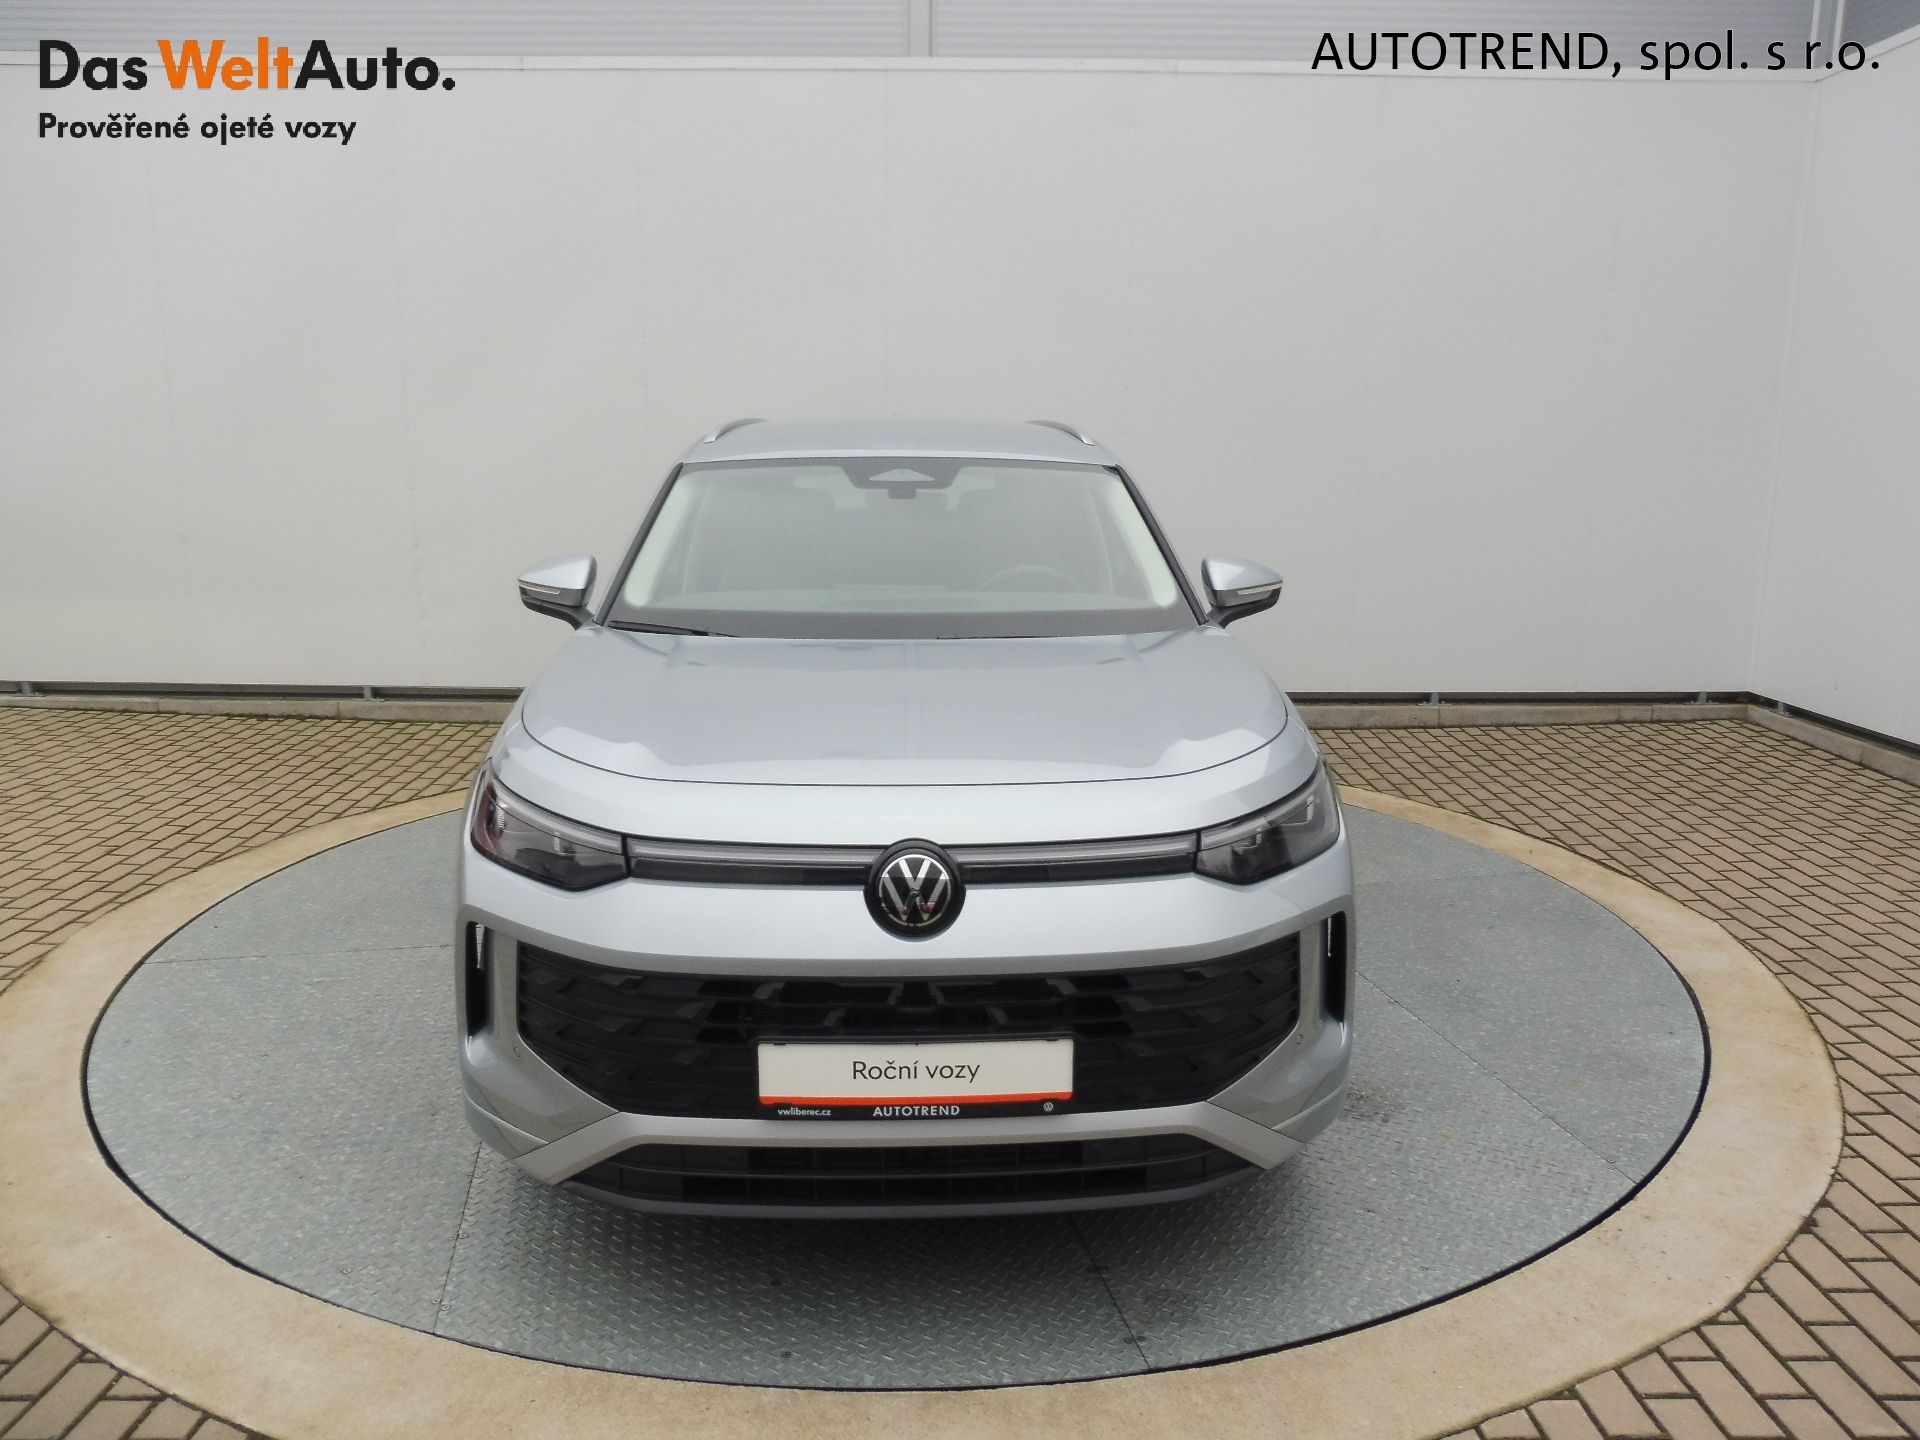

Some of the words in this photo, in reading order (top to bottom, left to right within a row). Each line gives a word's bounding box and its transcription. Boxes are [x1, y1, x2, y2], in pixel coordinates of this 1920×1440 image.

[852, 1060, 919, 1081] Roční
[926, 1063, 981, 1083] vozy
[777, 1107, 832, 1117] vwliberec.cz
[872, 1105, 960, 1118] AUTOTREND
